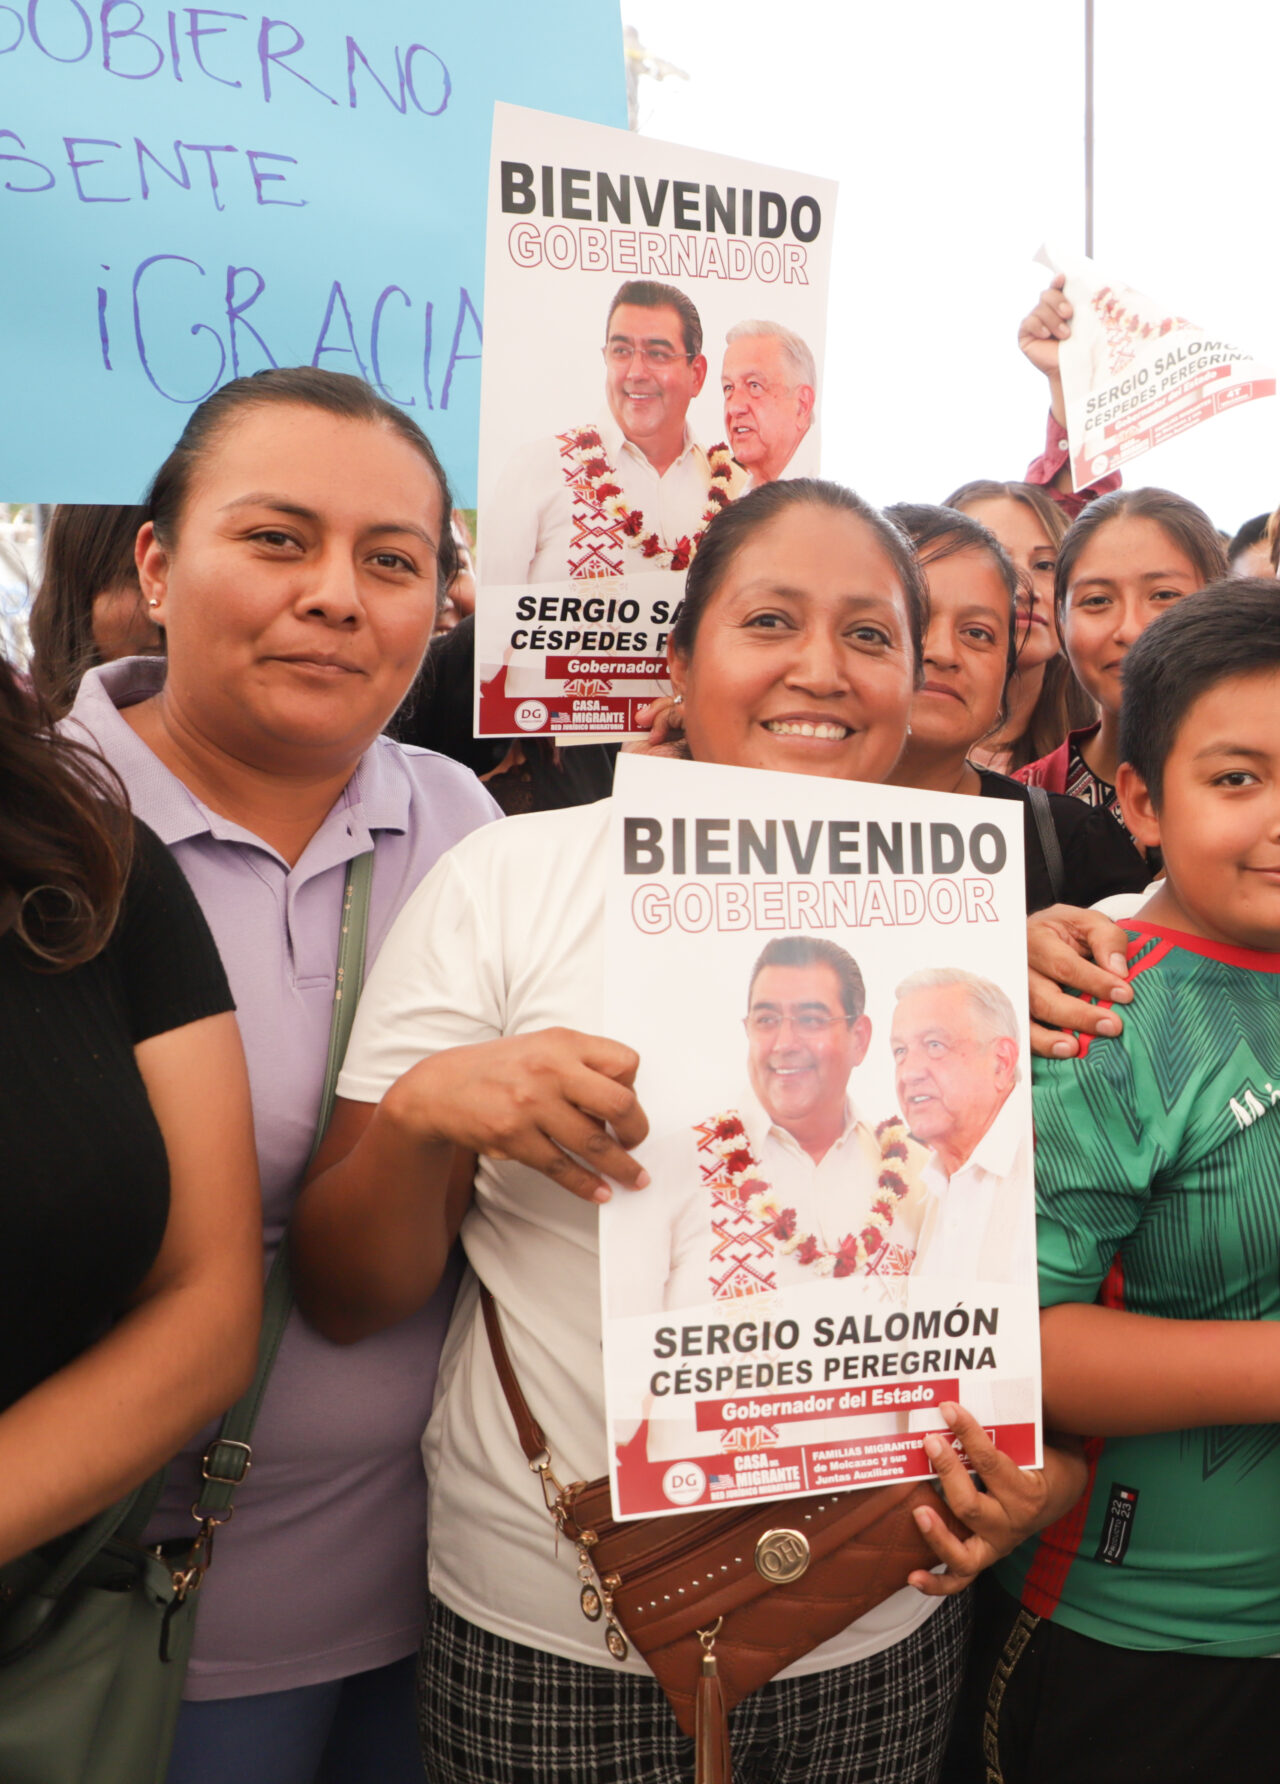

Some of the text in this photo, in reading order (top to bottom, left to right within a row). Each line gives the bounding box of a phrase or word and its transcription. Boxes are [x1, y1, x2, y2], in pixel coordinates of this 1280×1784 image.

[500, 160, 822, 243] BIENVENIDO
[508, 222, 809, 285] GOBERNADOR
[1086, 369, 1148, 414] SERGIO
[515, 596, 640, 624] SERGIO
[510, 625, 648, 651] CÉSPEDES
[567, 660, 662, 674] Gobernador
[521, 709, 541, 719] DG
[572, 700, 600, 711] CASA
[572, 712, 624, 723] MIGRANTE
[623, 817, 1007, 875] BIENVENIDO
[631, 878, 999, 934] GOBERNADOR
[652, 1301, 999, 1359] SERGIO SALOMÓN
[650, 1346, 997, 1397] CÉSPEDES PEREGRINA
[722, 1385, 935, 1422] Gobernador del Estado
[812, 1439, 923, 1461] FAMILIAS MIGRANTES
[734, 1453, 768, 1471] CASA
[813, 1455, 907, 1473] de Molcaxac y sus
[672, 1473, 697, 1488] DG
[735, 1466, 800, 1489] MIGRANTE
[815, 1466, 904, 1486] Juntas Auxiliares
[1111, 1500, 1122, 1516] 22
[1120, 1503, 1132, 1519] 23
